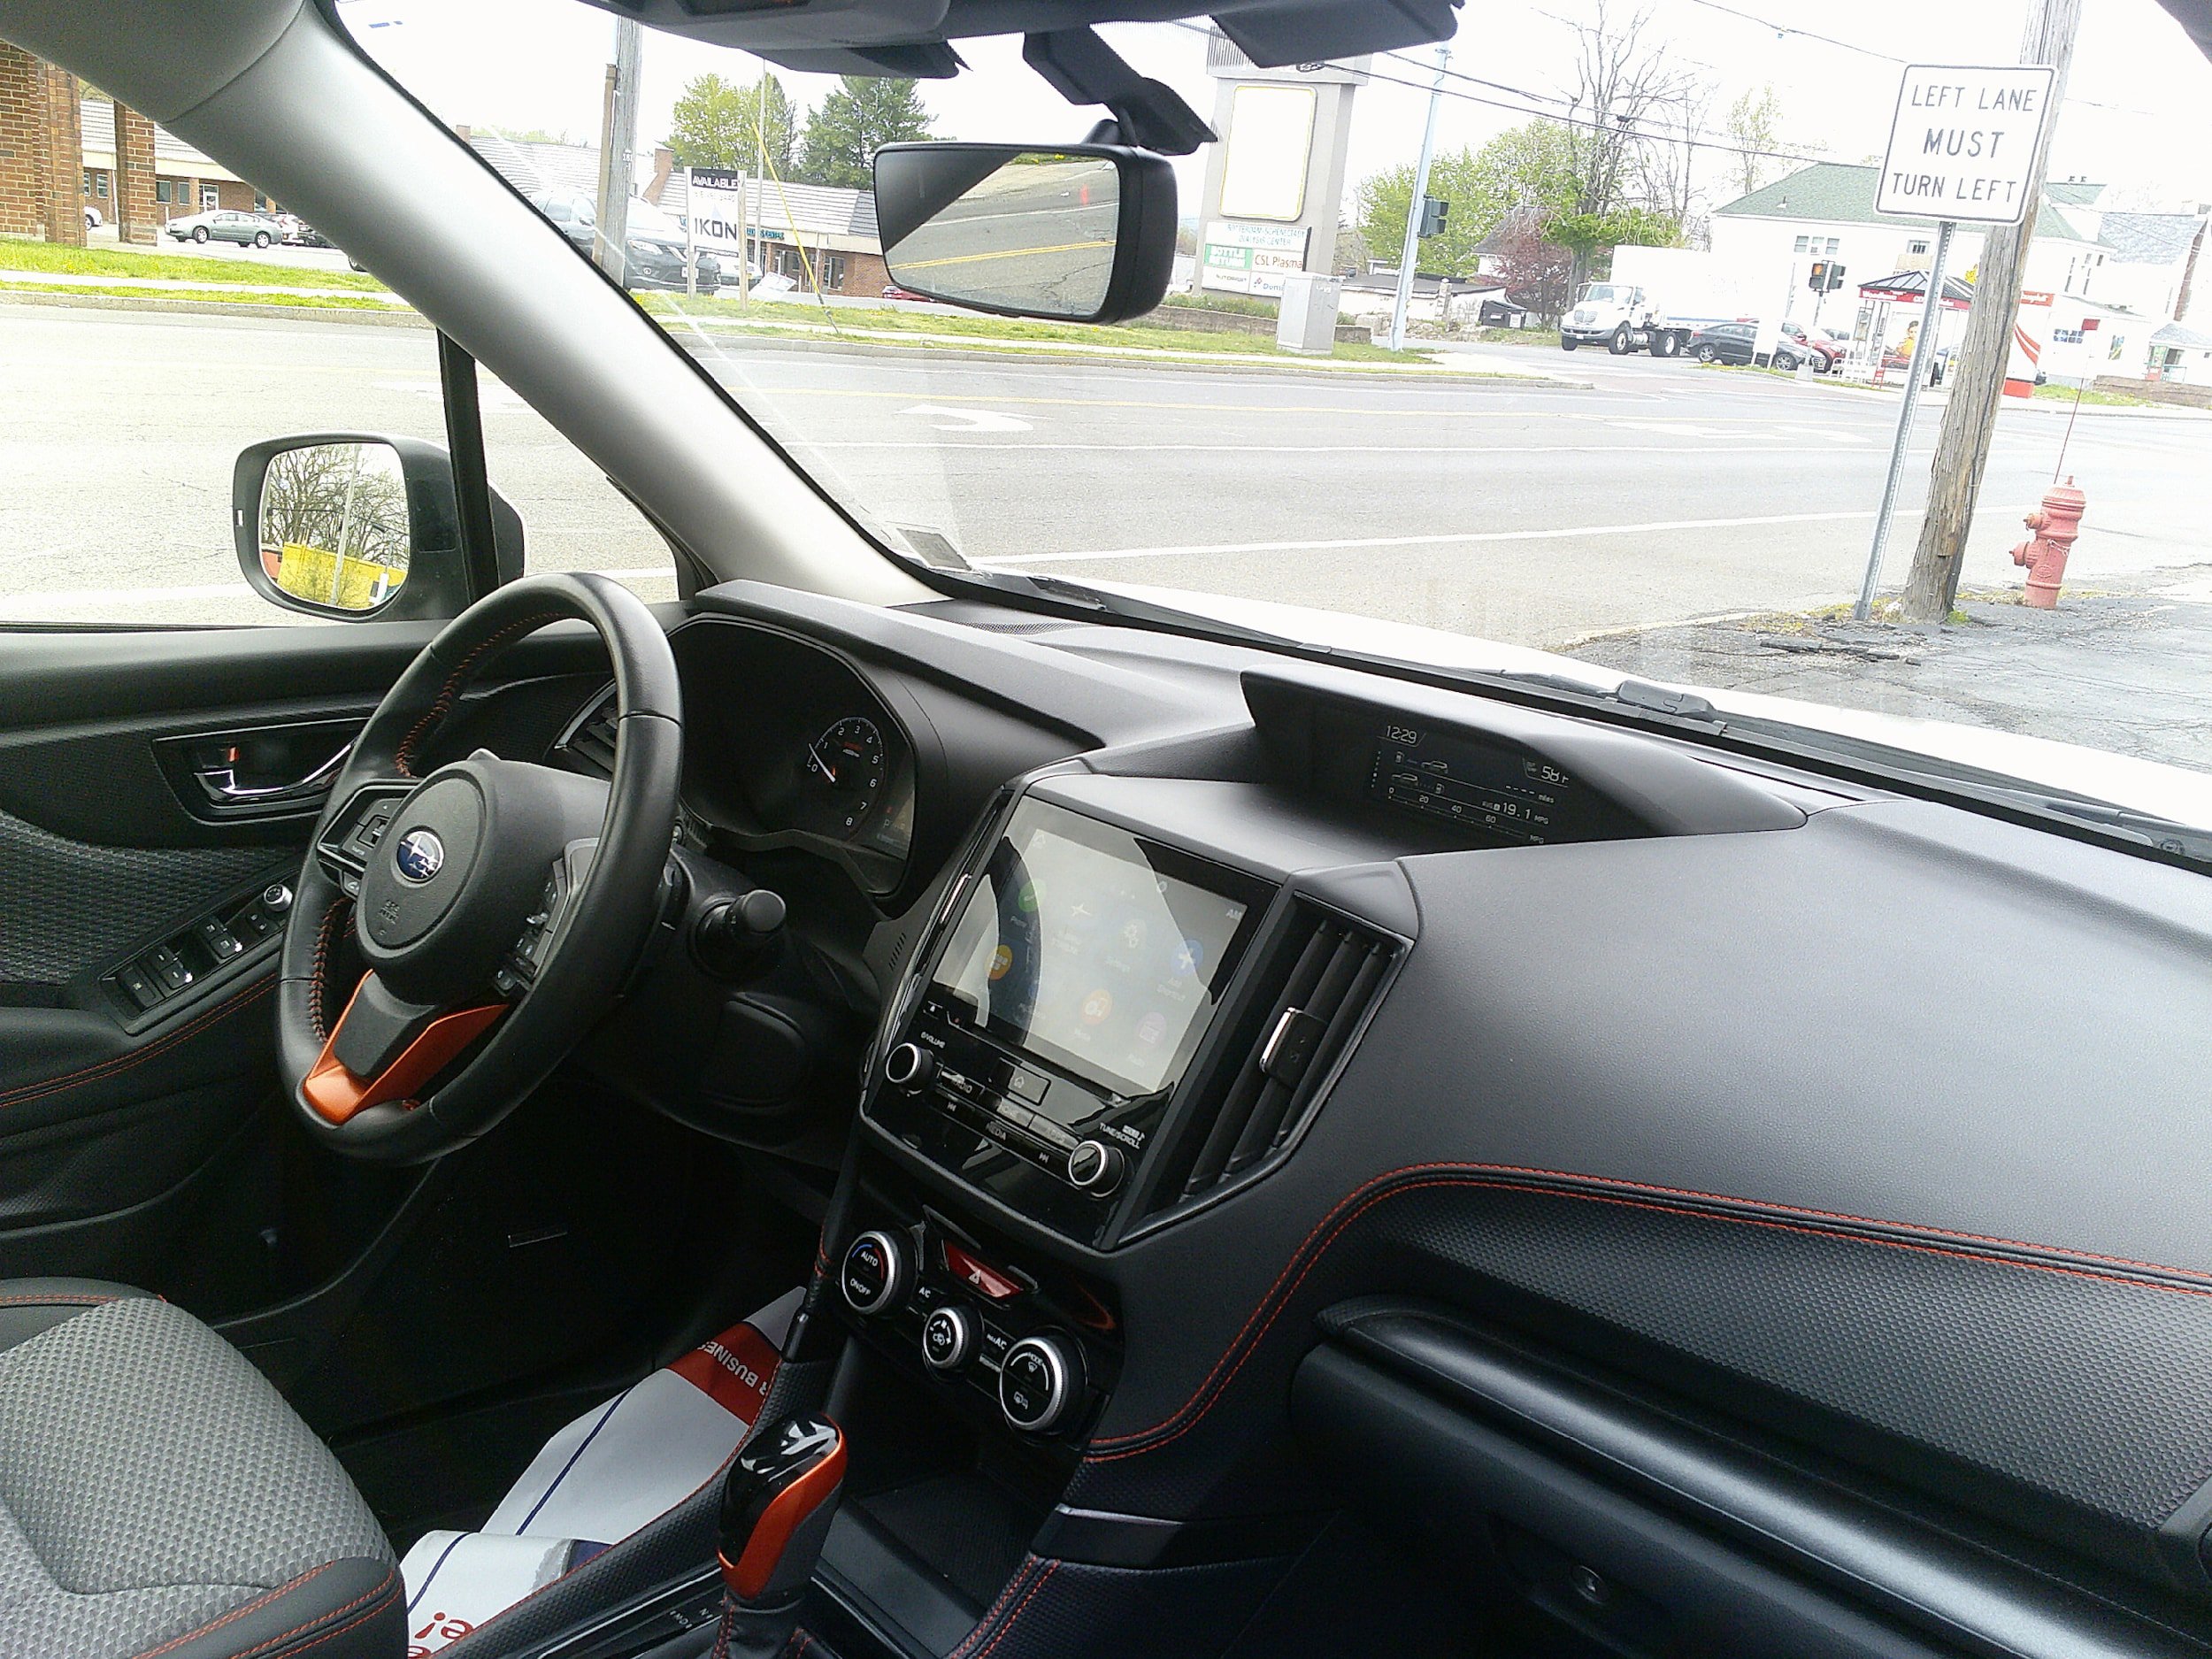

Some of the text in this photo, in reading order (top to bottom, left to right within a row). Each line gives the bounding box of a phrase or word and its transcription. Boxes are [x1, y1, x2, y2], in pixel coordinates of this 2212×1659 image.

[1912, 85, 2037, 111] LEFT LANE
[1923, 128, 2005, 158] MUST
[692, 176, 739, 189] AVAILABLE
[1893, 173, 2017, 203] TURN LEFT
[695, 218, 737, 241] IKON
[1255, 254, 1303, 268] CSL Plasma
[837, 727, 845, 736] 2
[854, 726, 861, 734] 3
[866, 735, 873, 744] 4
[872, 756, 879, 764] 5
[810, 764, 818, 772] 0
[869, 778, 878, 788] 6
[860, 801, 868, 810] 7
[1419, 795, 1429, 804] 20
[1451, 805, 1463, 814] 40
[1502, 802, 1531, 820] 19.1
[845, 817, 854, 826] 8
[1099, 1122, 1141, 1150] TUNE/SCROLL
[860, 1250, 879, 1268] AUTO
